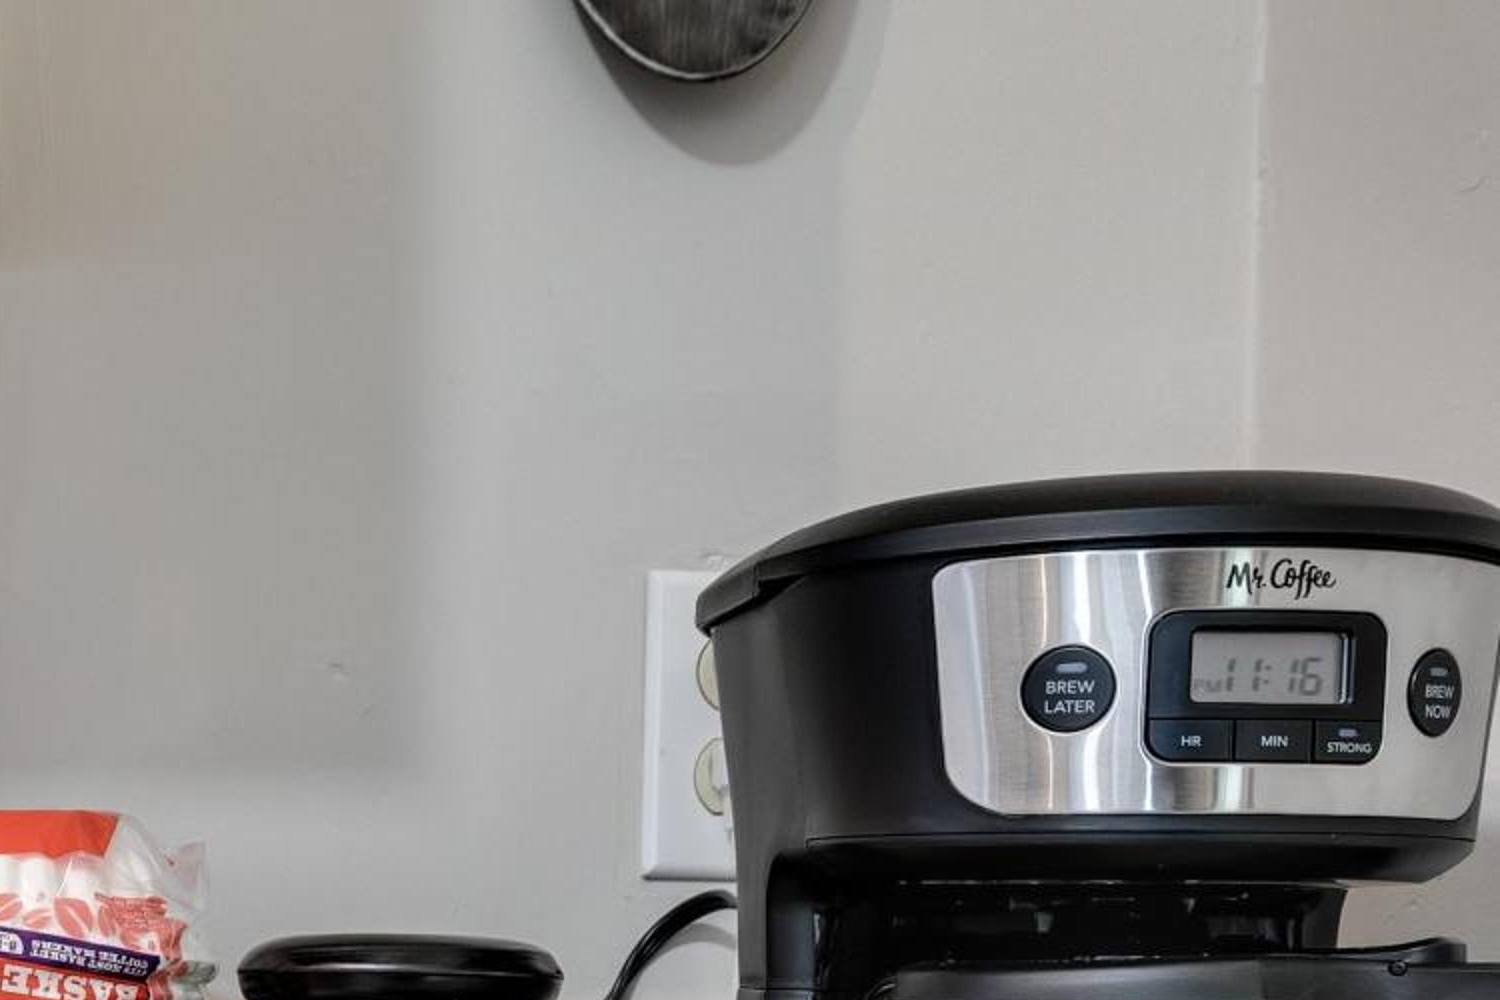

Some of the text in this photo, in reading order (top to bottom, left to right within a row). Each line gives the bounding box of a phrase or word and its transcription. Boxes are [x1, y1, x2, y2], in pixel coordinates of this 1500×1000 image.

[1226, 558, 1337, 599] Mr. Coffee
[1224, 656, 1323, 696] 11:16
[1045, 679, 1095, 694] BREW
[1425, 685, 1455, 699] BREW
[1044, 699, 1095, 715] LATER
[1425, 704, 1451, 719] NOW
[1181, 735, 1202, 747] HR
[1260, 735, 1289, 747] MIN
[1326, 741, 1372, 754] STRONG
